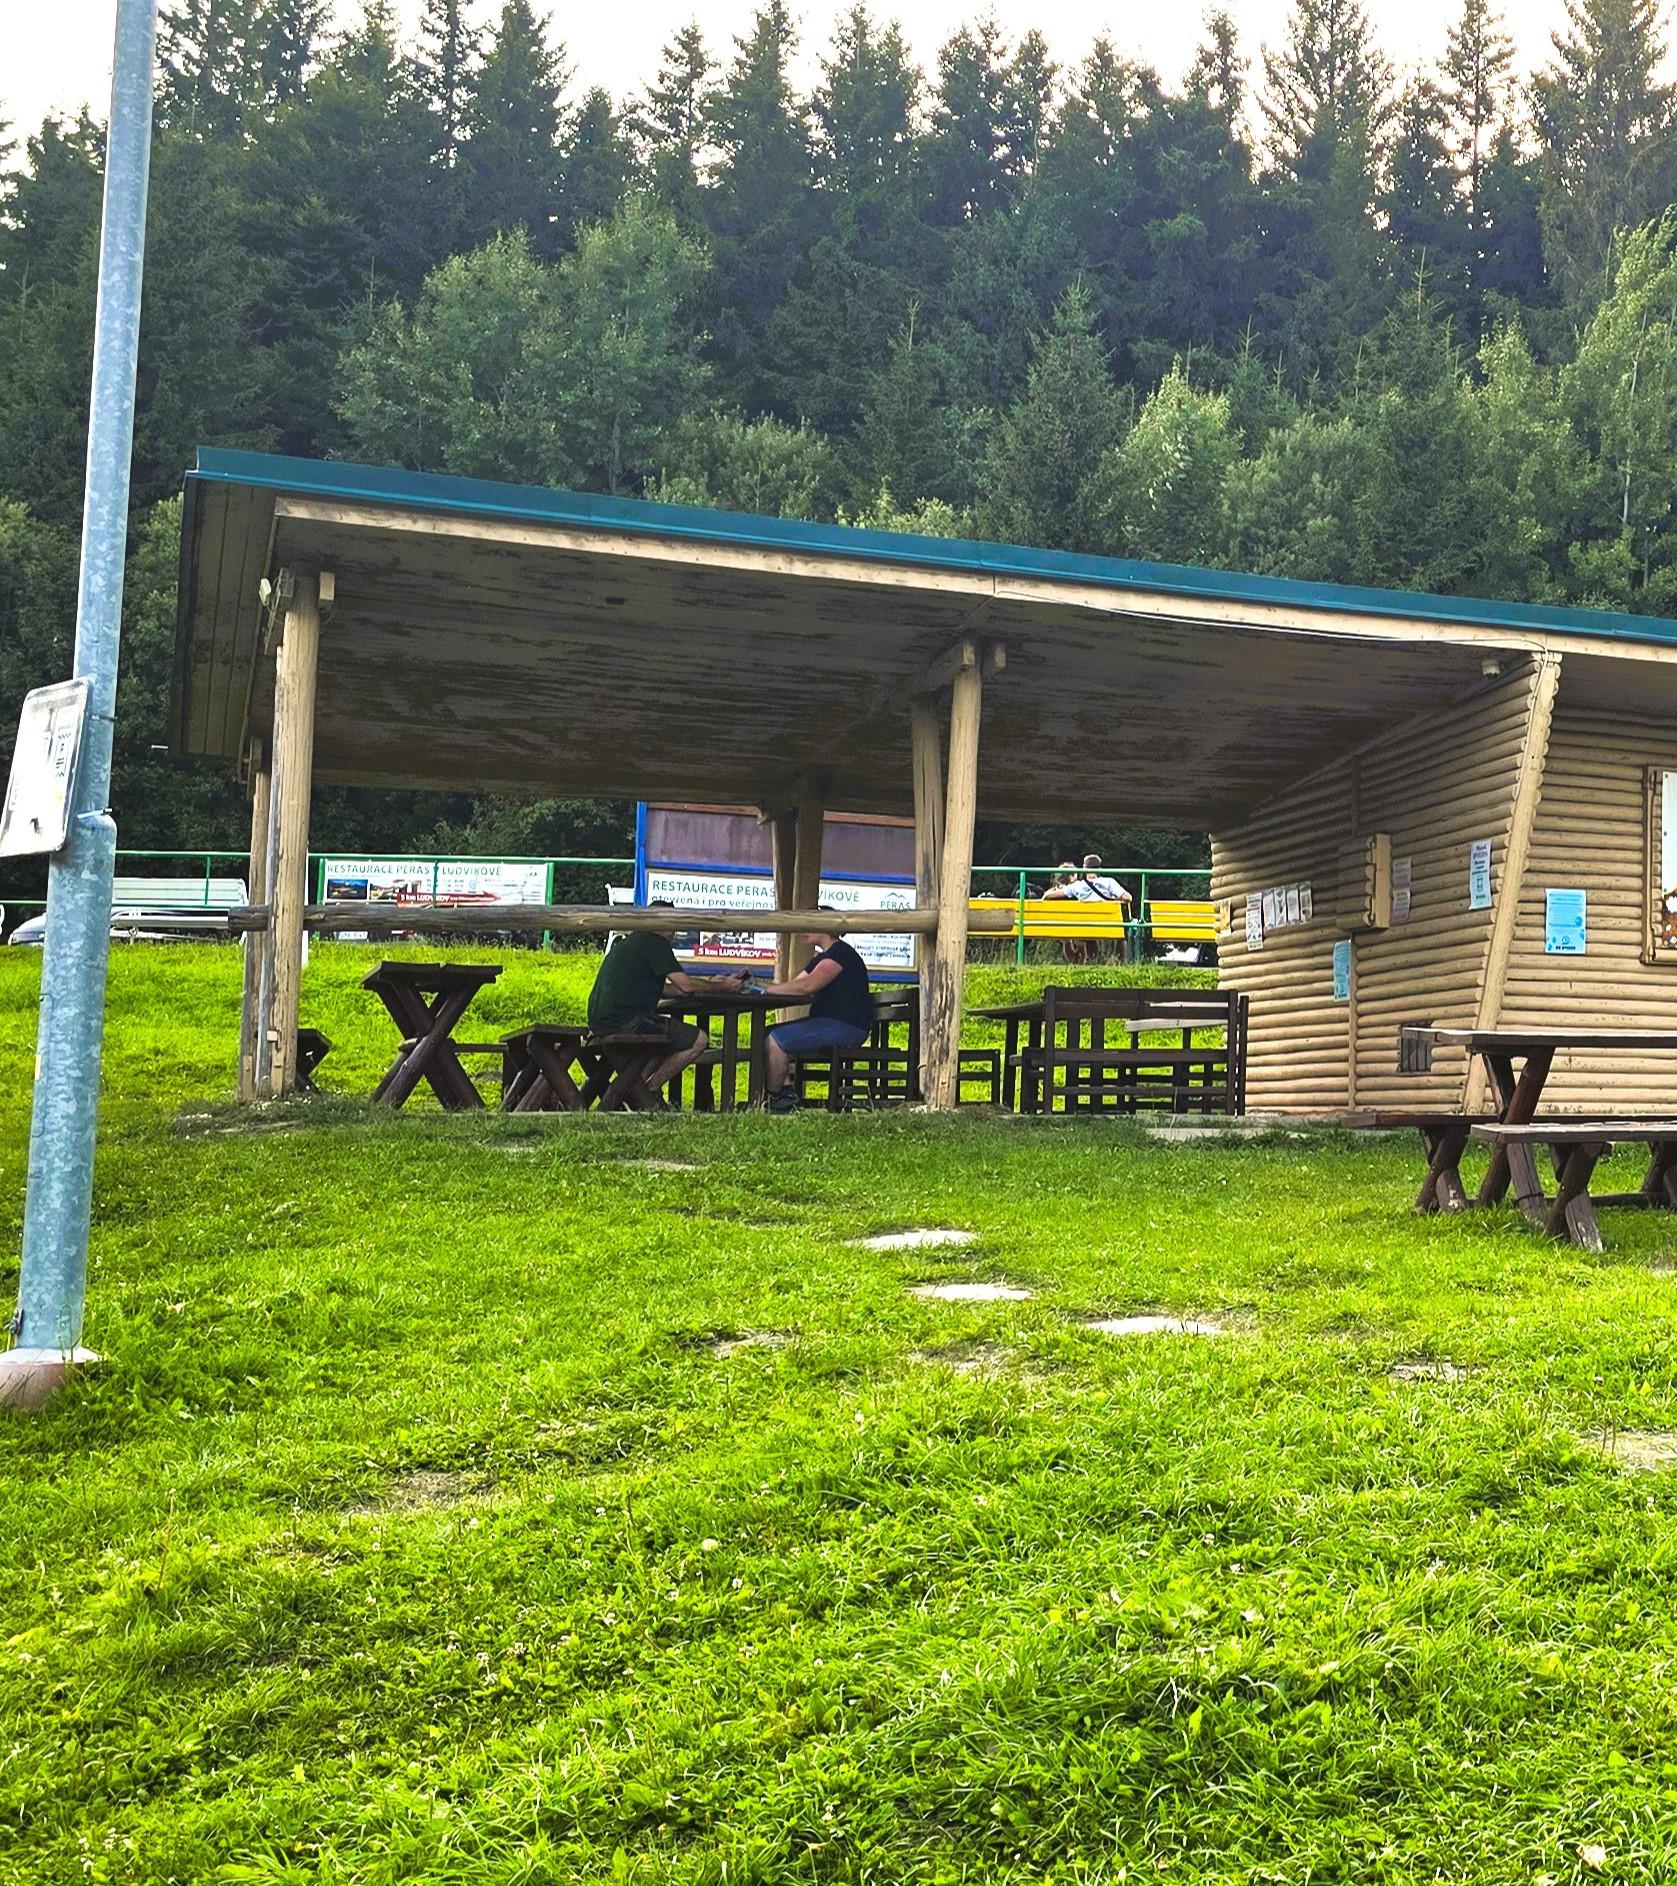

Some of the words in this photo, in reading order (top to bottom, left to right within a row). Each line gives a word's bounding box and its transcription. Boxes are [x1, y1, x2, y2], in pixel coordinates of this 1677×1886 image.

[327, 864, 393, 874] RESTAURACE
[396, 865, 430, 875] PERAS
[653, 879, 734, 895] RESTAURACE
[736, 884, 776, 898] PERAS
[708, 897, 726, 908] pro
[729, 898, 775, 910] veřejnos
